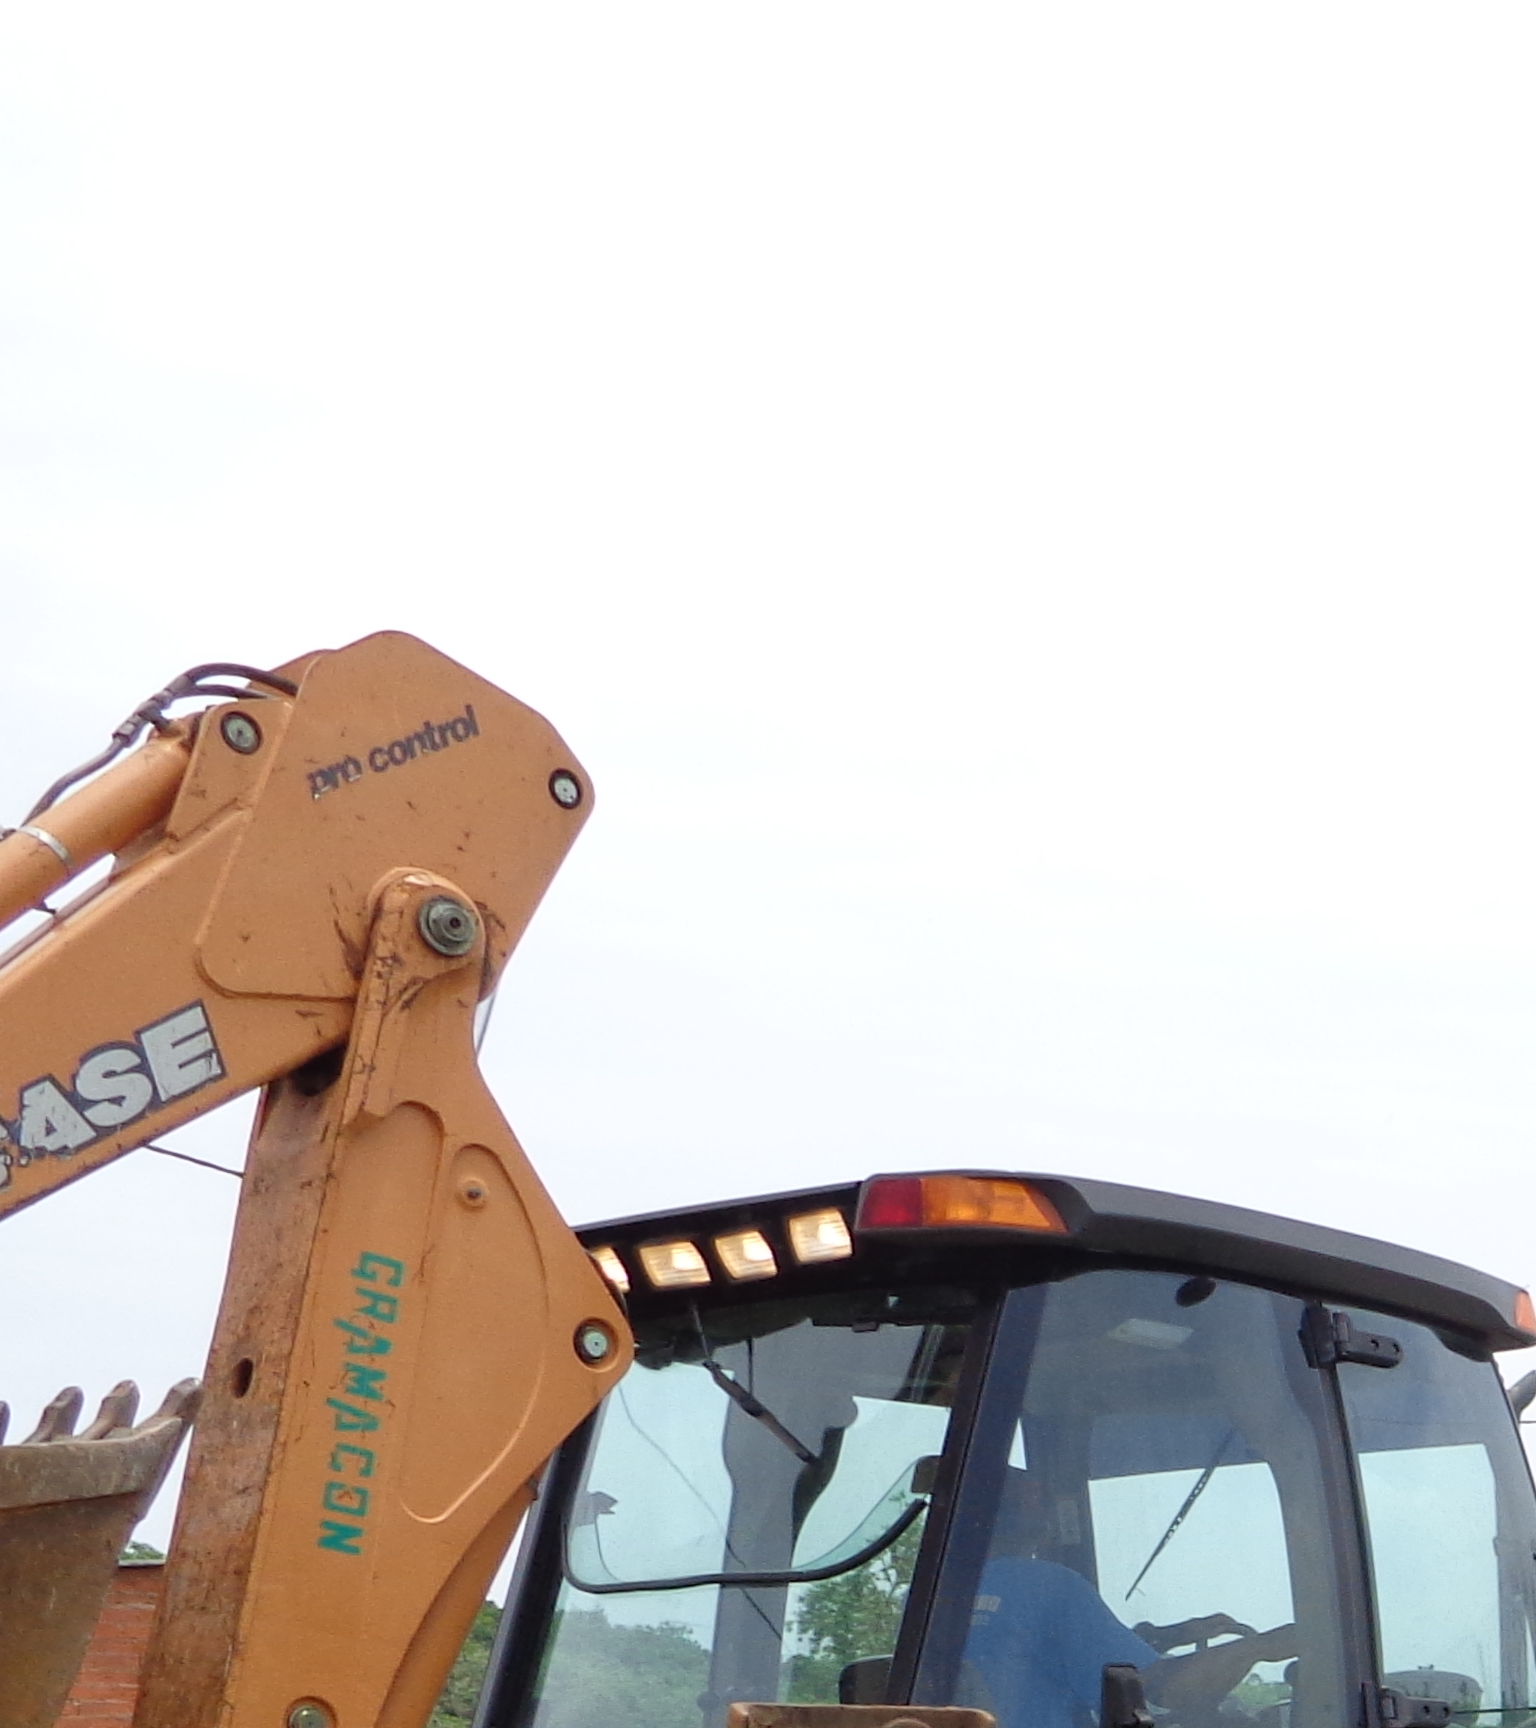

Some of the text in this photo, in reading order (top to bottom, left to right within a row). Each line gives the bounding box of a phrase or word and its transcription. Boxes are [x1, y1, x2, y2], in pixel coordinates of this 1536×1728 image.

[306, 703, 481, 801] pro control
[0, 999, 227, 1188] ASE
[317, 1250, 405, 1556] GRAMACON
